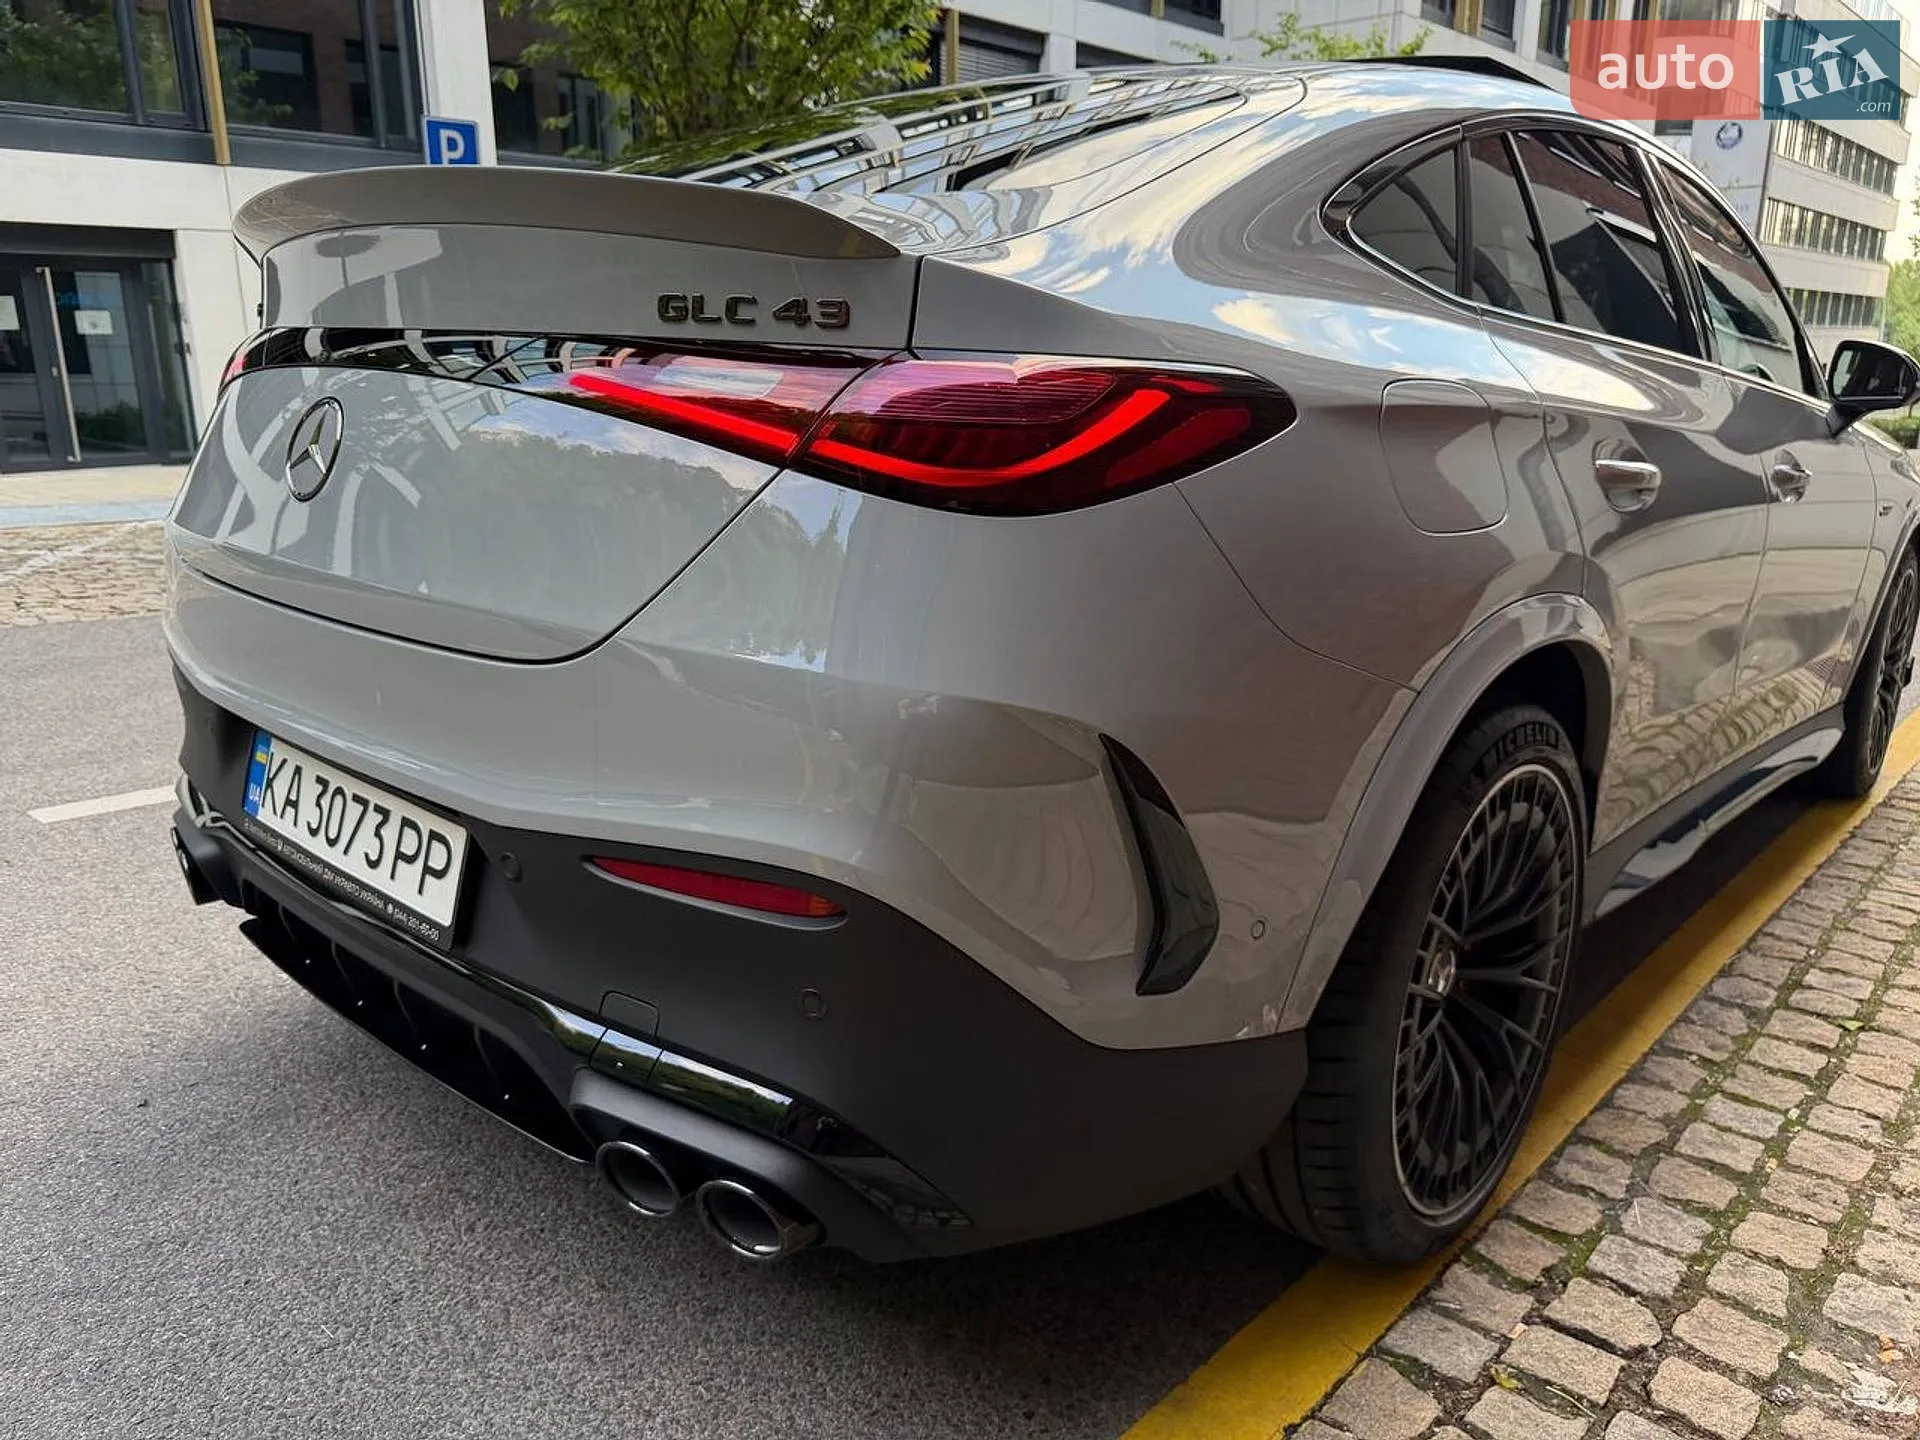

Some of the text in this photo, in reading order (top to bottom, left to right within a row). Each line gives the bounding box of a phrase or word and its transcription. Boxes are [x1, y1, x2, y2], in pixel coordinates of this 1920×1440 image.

[439, 128, 465, 167] P
[657, 292, 851, 329] GLC 43
[248, 783, 261, 803] UA
